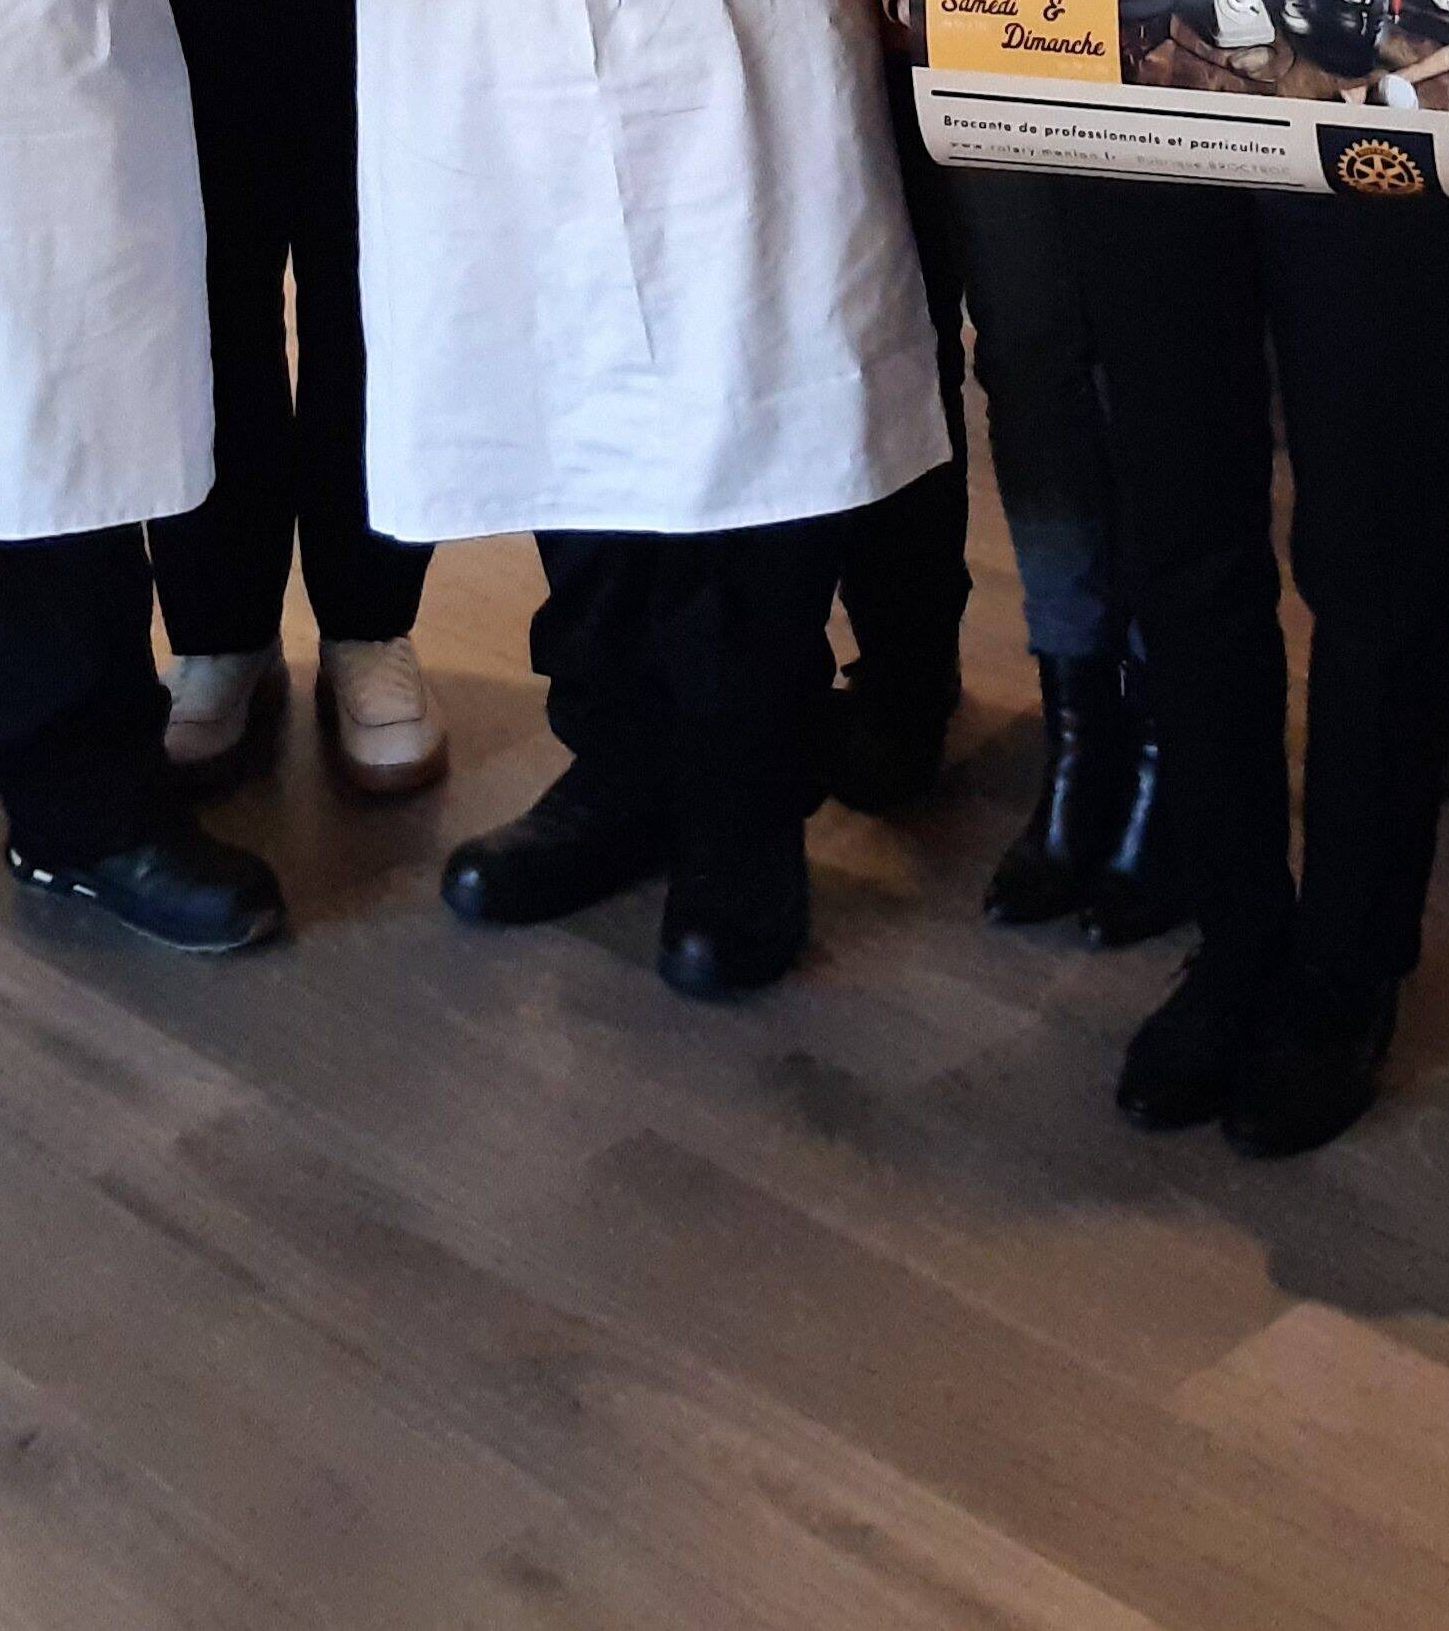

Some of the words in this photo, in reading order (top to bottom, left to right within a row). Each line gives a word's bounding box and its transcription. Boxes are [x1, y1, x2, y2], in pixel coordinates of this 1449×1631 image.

[1001, 22, 1106, 57] Dimanche
[944, 115, 1012, 132] Brocante
[1019, 122, 1038, 134] de
[1044, 125, 1161, 145] professionnels
[1167, 136, 1183, 146] et
[1190, 139, 1287, 156] particuliers
